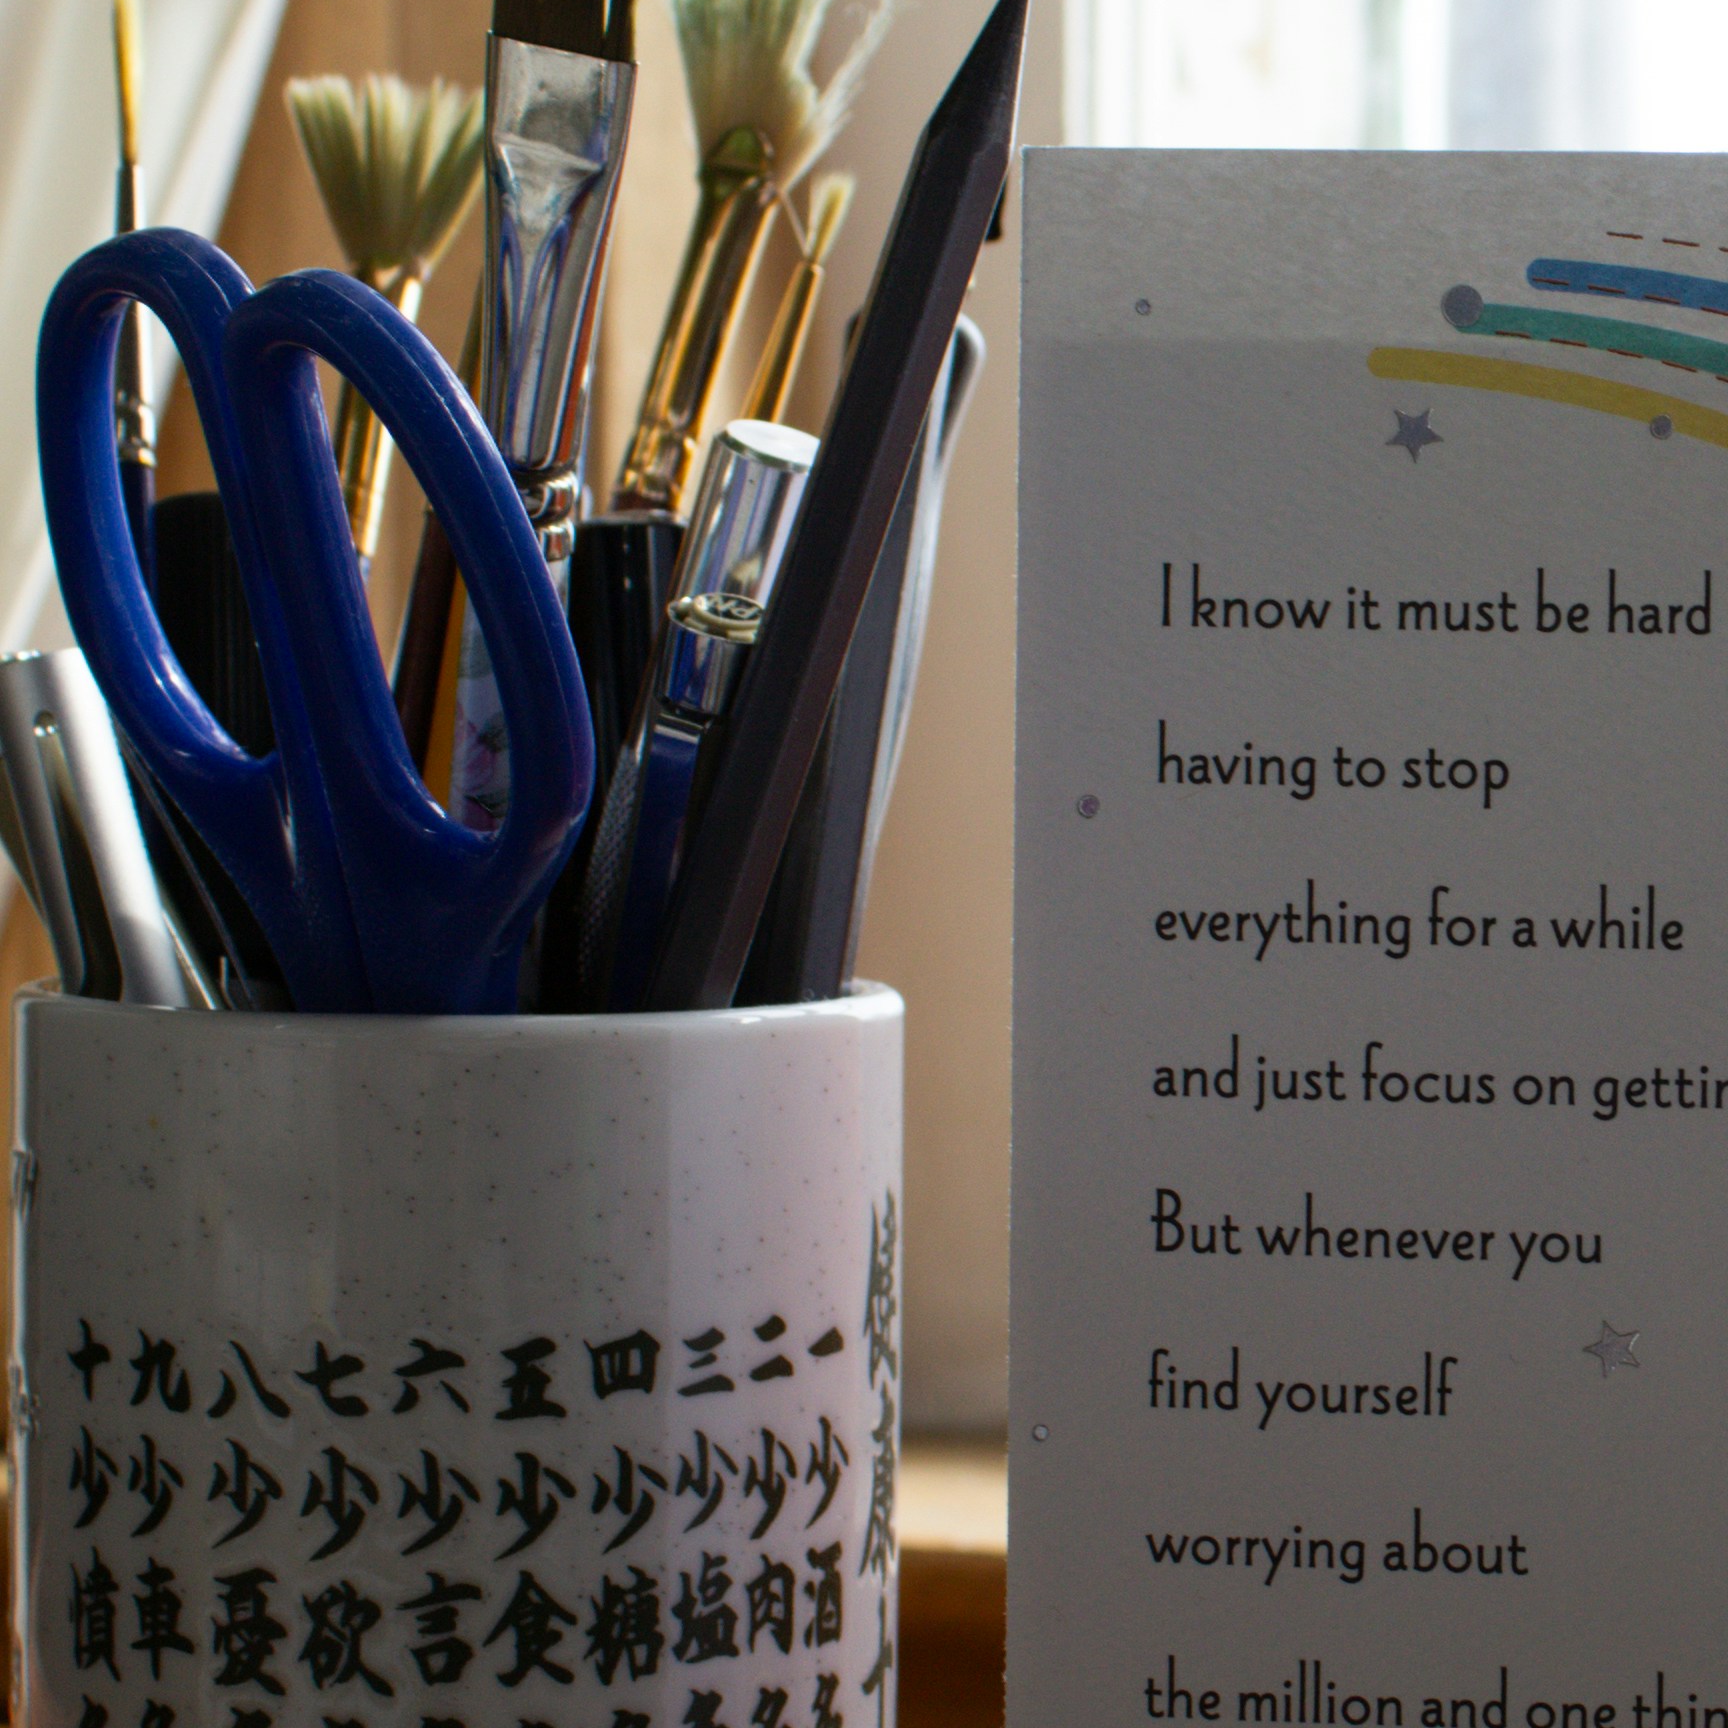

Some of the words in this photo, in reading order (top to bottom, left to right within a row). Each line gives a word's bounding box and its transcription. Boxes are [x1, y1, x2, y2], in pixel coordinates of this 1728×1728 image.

[1160, 561, 1173, 628] I
[1190, 561, 1332, 631] know
[1346, 585, 1382, 632] it
[1397, 590, 1520, 634] must
[1535, 566, 1591, 635] be
[1606, 567, 1713, 637] hard
[1157, 718, 1317, 802] having
[1332, 745, 1387, 789] to
[1401, 747, 1511, 811] stop
[1153, 877, 1412, 963] everything
[1427, 884, 1498, 948] for
[1511, 916, 1538, 949] a
[1549, 882, 1685, 952] while
[1151, 1032, 1240, 1100] and
[1253, 1054, 1348, 1113] just
[1360, 1040, 1497, 1106] focus
[1511, 1073, 1576, 1107] on
[1149, 1187, 1243, 1257] But
[1255, 1190, 1496, 1263] whenever
[1508, 1231, 1603, 1283] you
[1147, 1345, 1240, 1412] find
[1254, 1350, 1459, 1432] yourself
[1144, 1524, 1366, 1588] worrying
[1381, 1506, 1530, 1577] about
[1143, 1653, 1222, 1722] the
[1237, 1658, 1404, 1728] million
